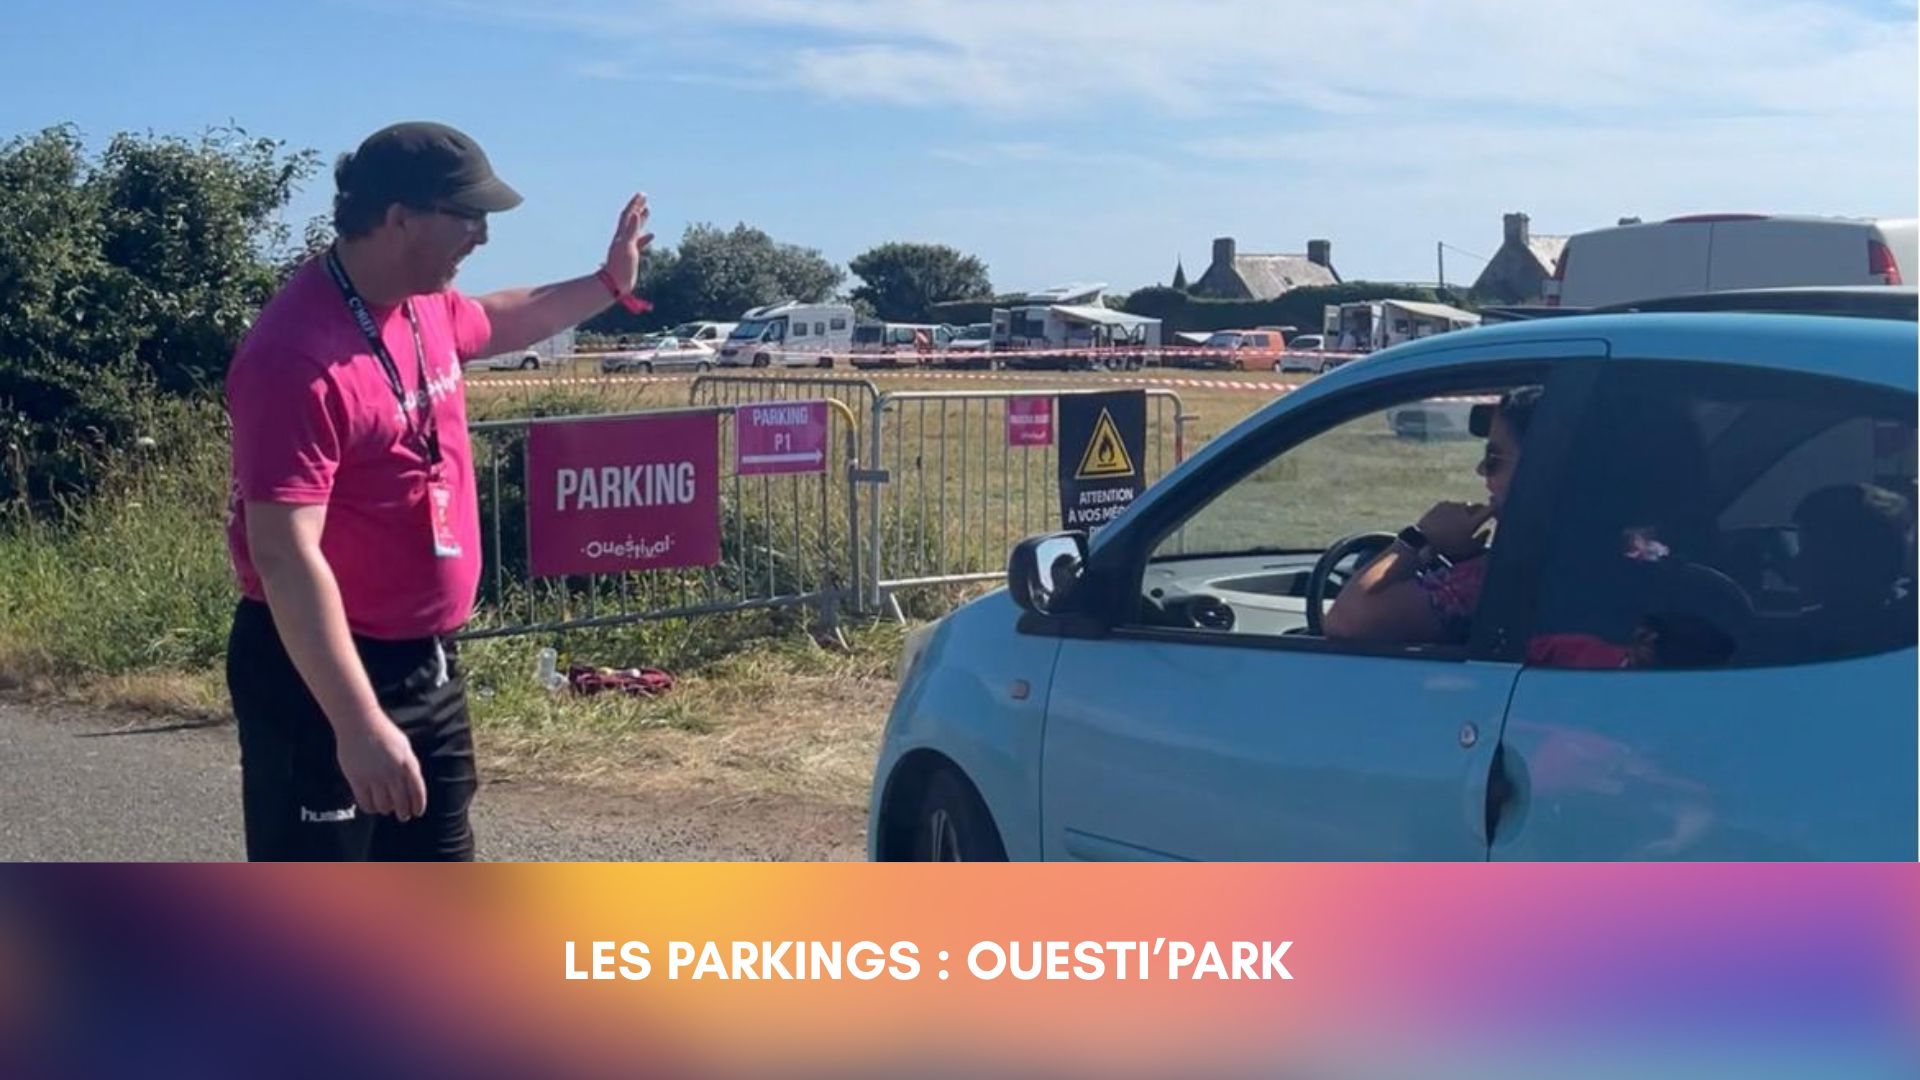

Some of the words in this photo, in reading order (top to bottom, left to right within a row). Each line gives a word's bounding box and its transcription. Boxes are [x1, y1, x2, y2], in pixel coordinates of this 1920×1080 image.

[752, 406, 809, 427] PARKING
[774, 433, 791, 451] P1
[556, 460, 696, 511] PARKING
[1079, 488, 1133, 504] ATTENTION
[1068, 506, 1078, 523] À
[1078, 507, 1102, 523] VOS
[585, 533, 671, 559] Ouestival
